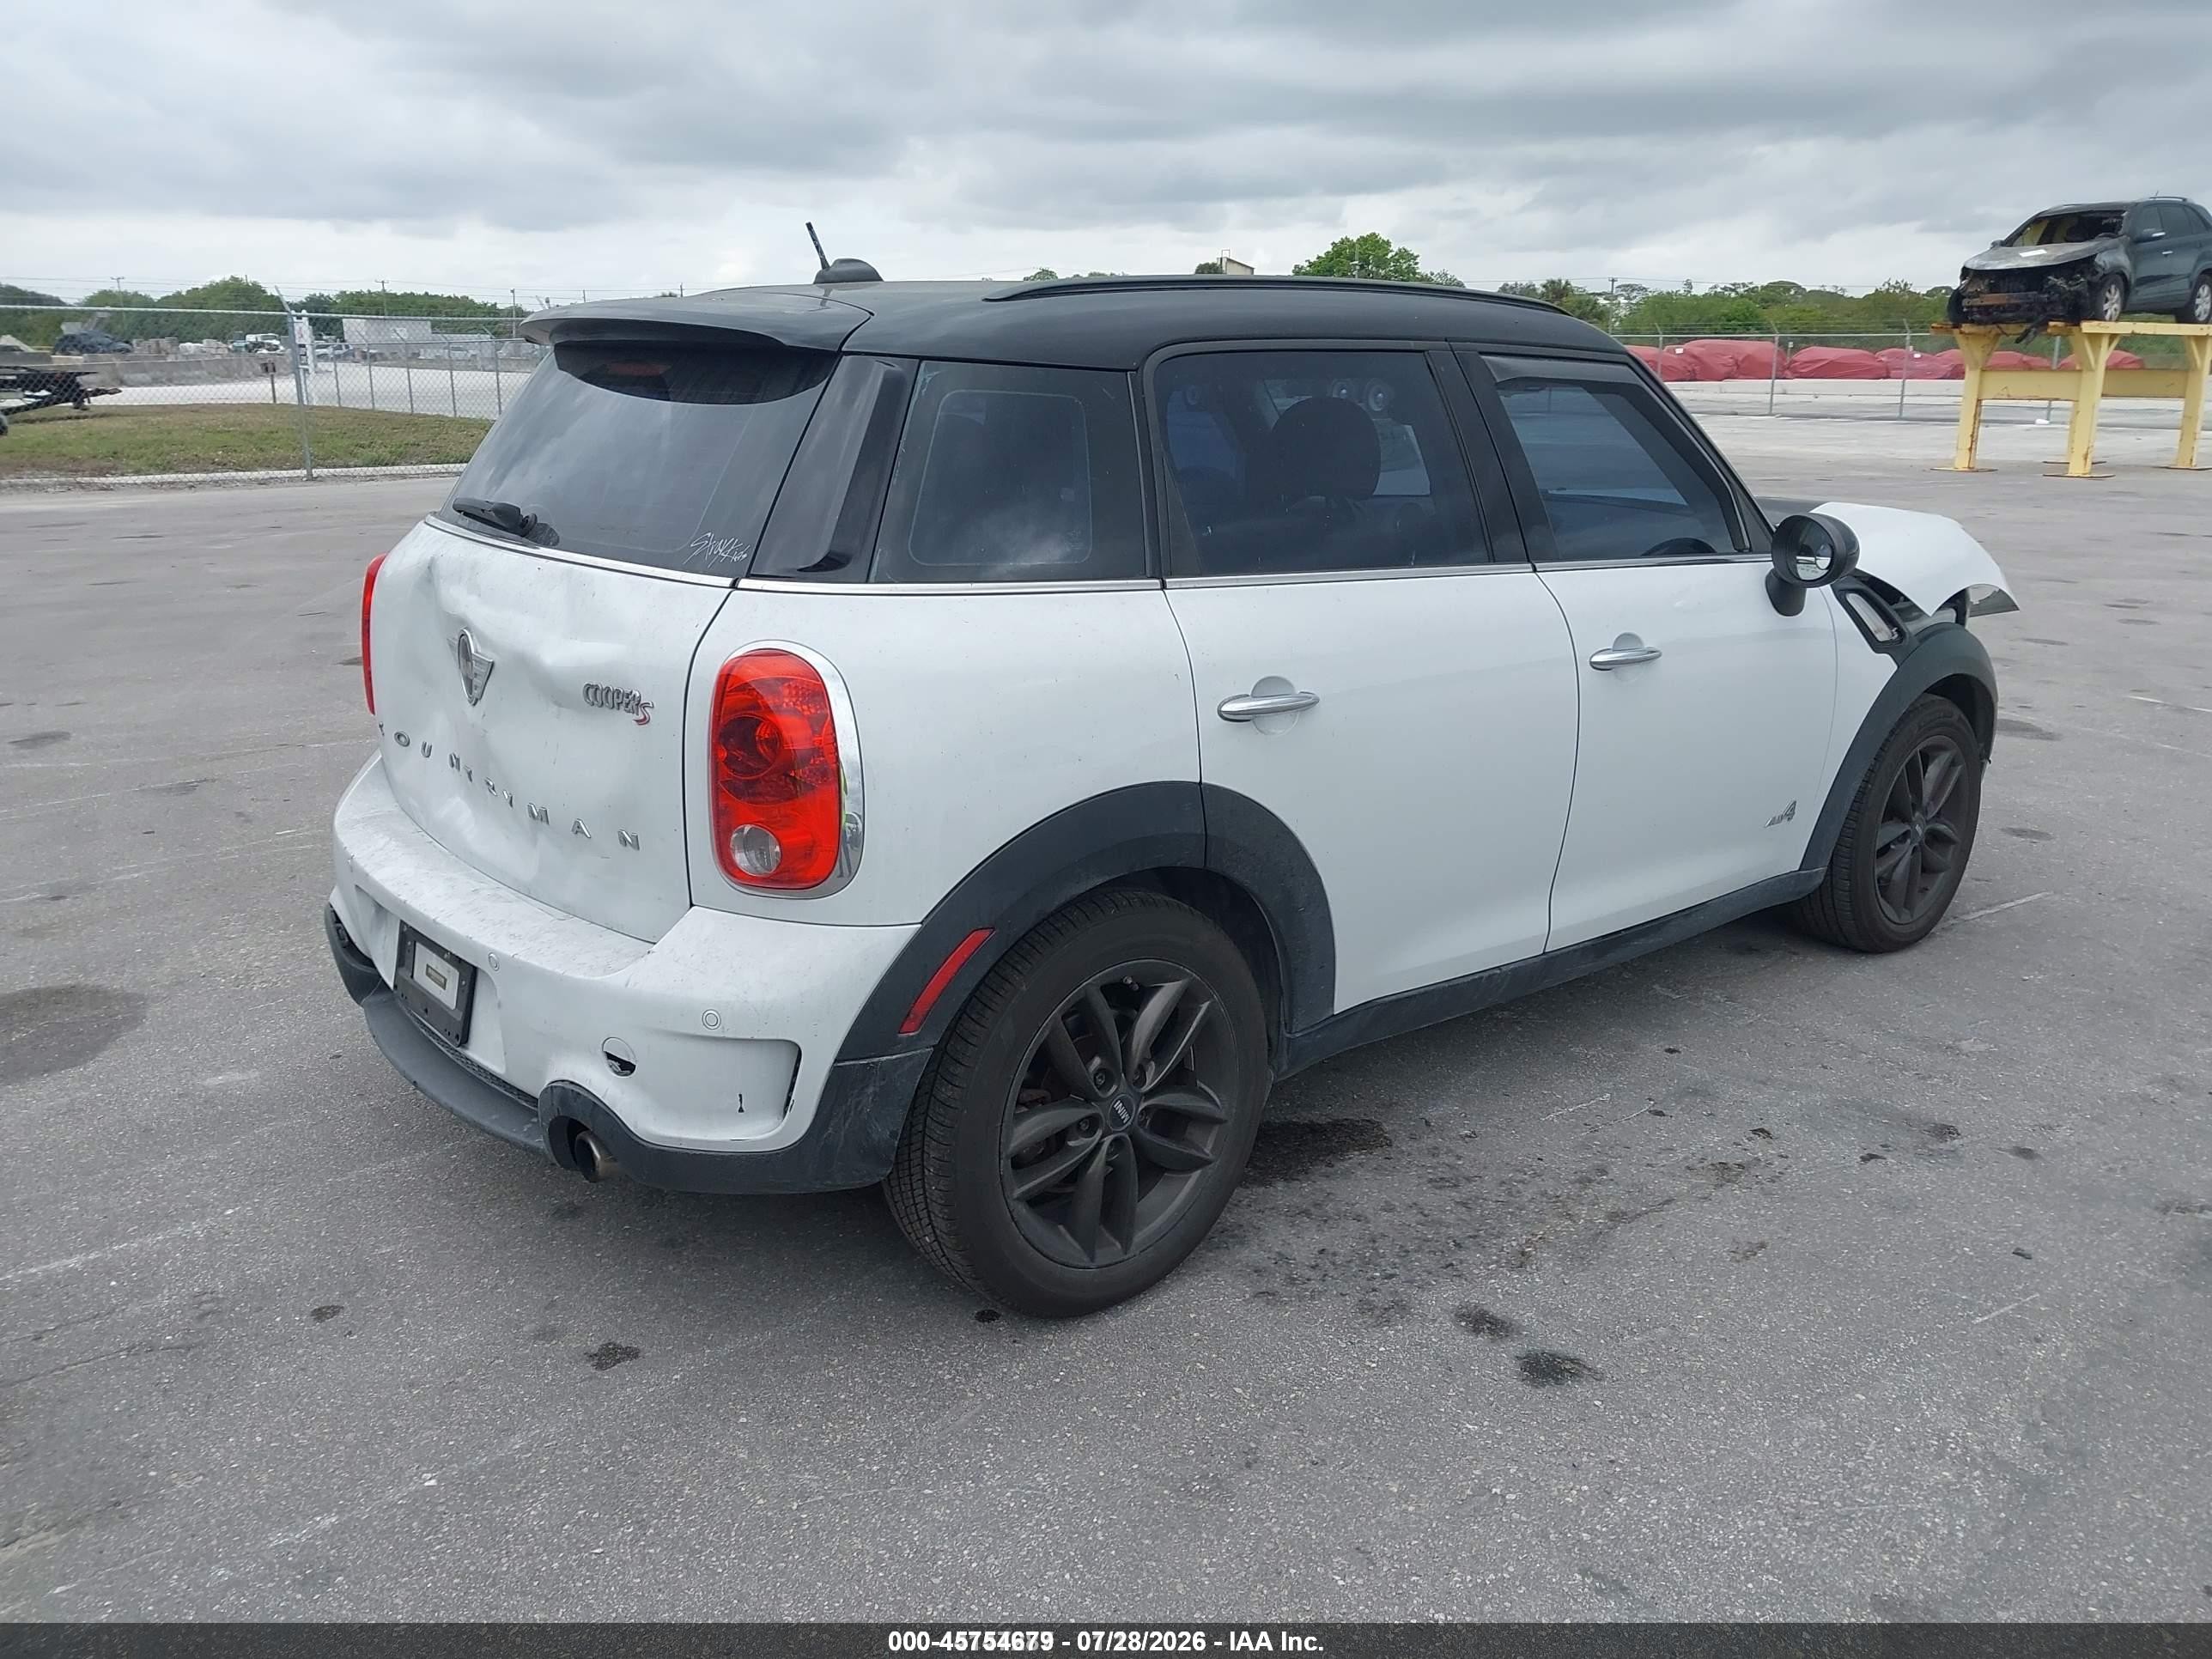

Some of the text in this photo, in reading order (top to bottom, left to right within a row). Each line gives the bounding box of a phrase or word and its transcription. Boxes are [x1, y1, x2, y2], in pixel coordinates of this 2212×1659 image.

[583, 682, 654, 726] COOPER S
[1113, 1099, 1131, 1124] MINI
